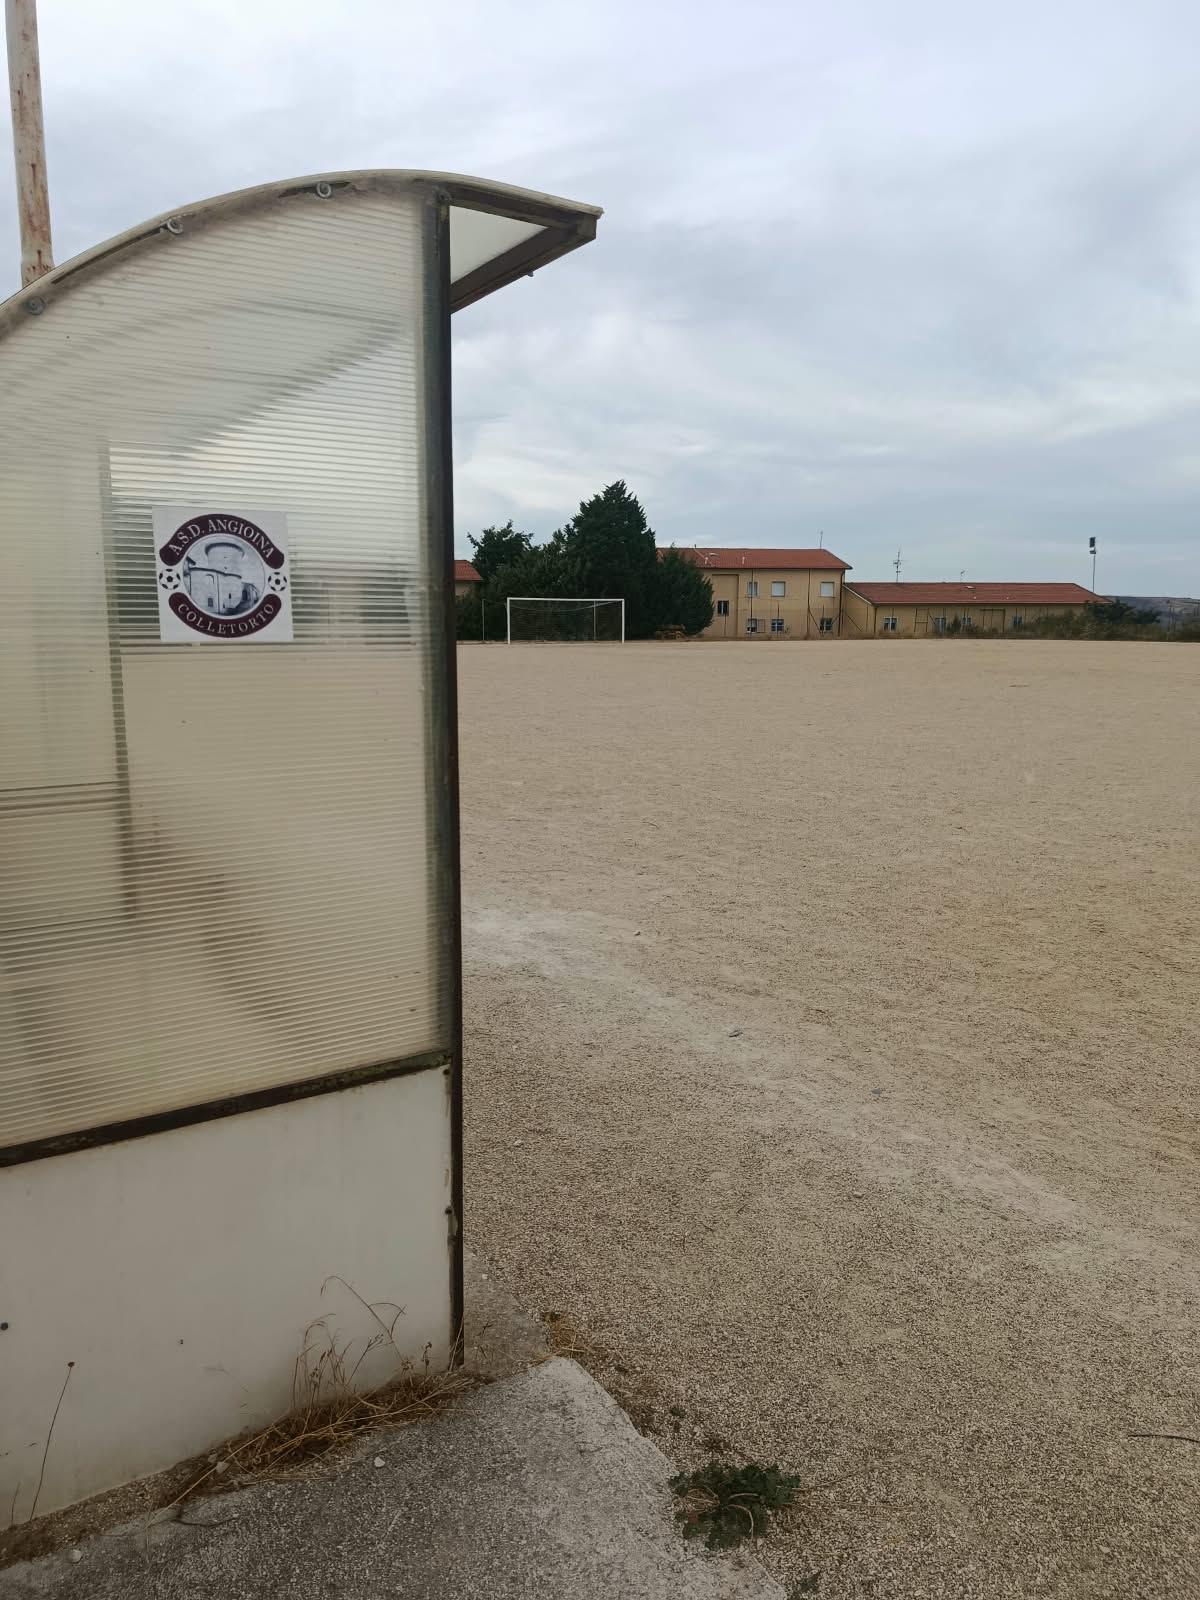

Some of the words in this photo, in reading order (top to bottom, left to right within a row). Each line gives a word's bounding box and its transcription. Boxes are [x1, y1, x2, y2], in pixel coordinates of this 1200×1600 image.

[168, 524, 205, 556] A.S.D.
[208, 519, 274, 558] ANGIOINA
[178, 603, 274, 634] COLLETORTO
